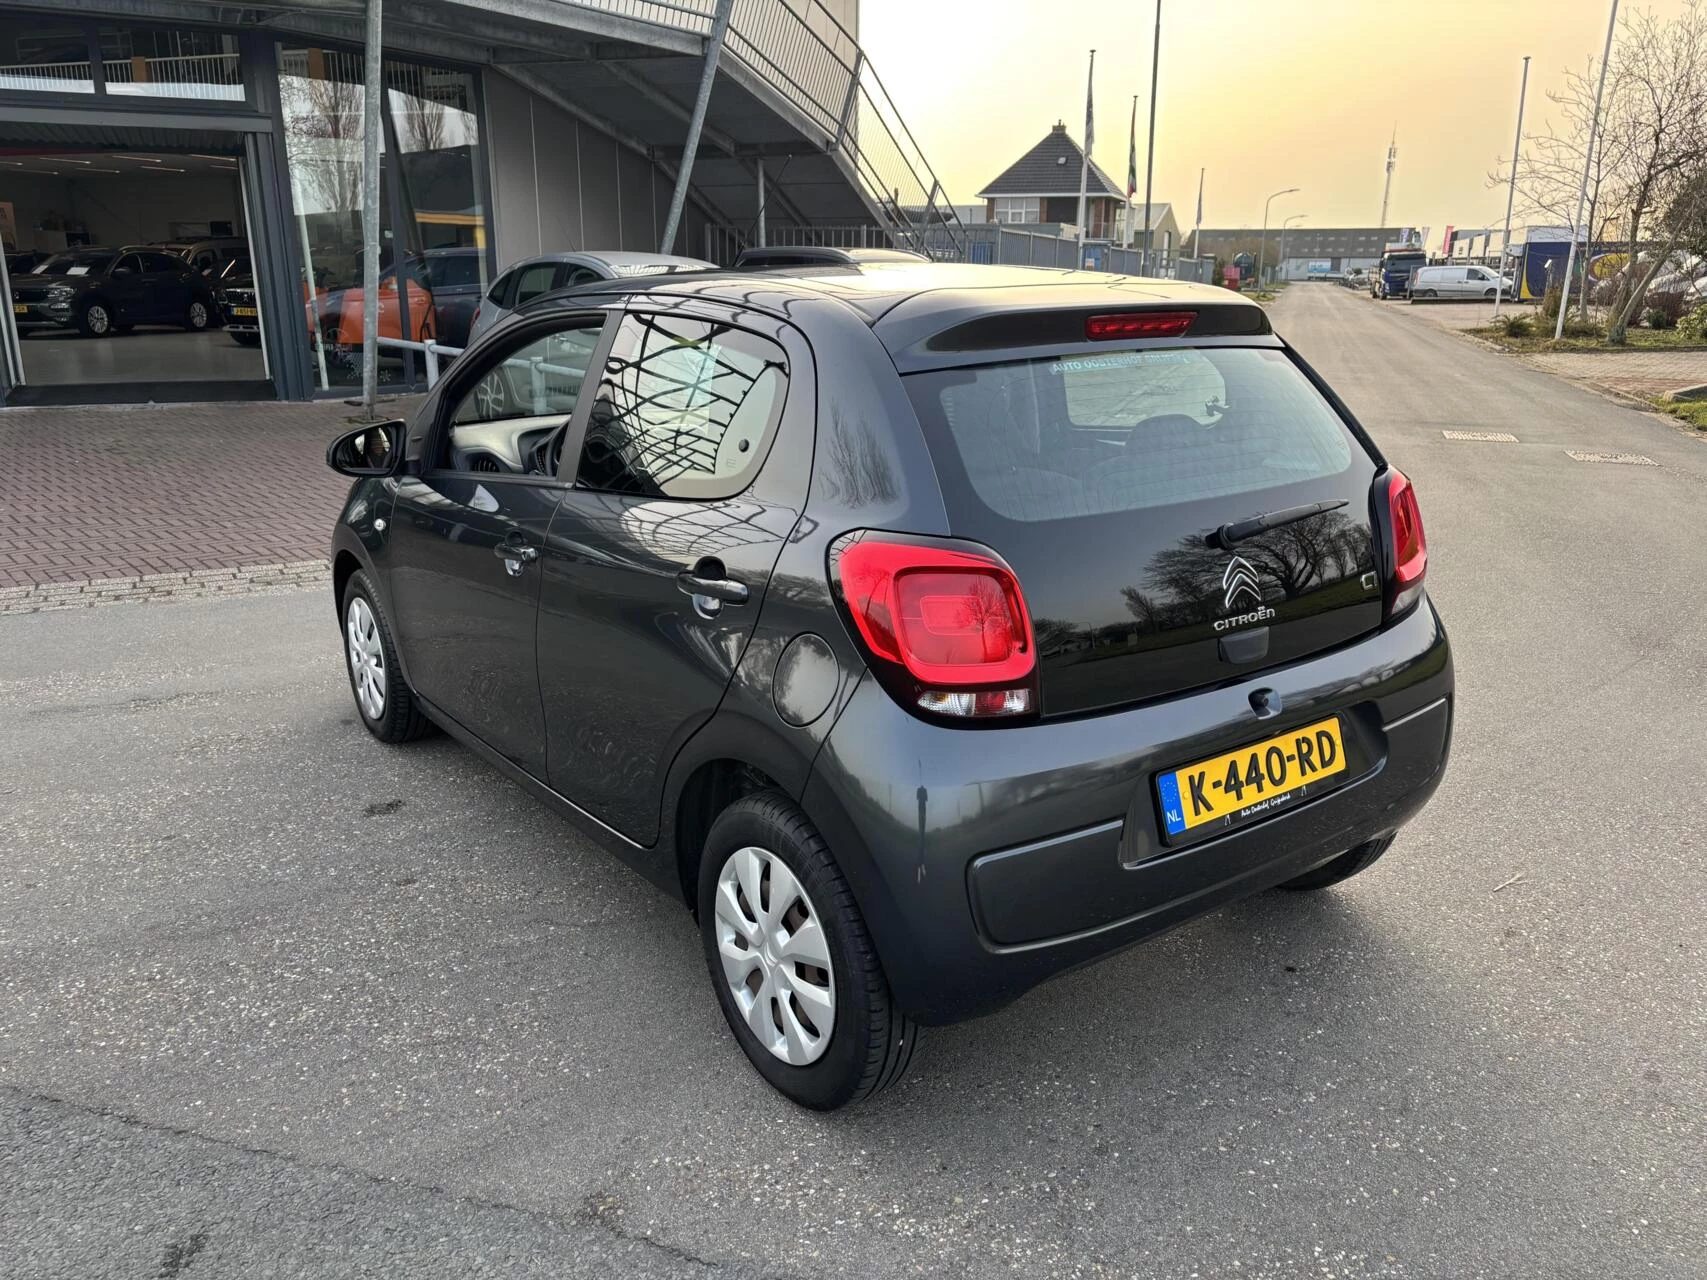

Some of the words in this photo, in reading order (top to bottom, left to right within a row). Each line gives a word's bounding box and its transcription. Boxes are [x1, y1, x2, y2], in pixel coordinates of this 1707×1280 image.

[1052, 361, 1082, 373] AUTO
[1213, 606, 1276, 631] CITROËN
[1166, 808, 1182, 825] NL
[1188, 729, 1337, 817] K-440-RD
